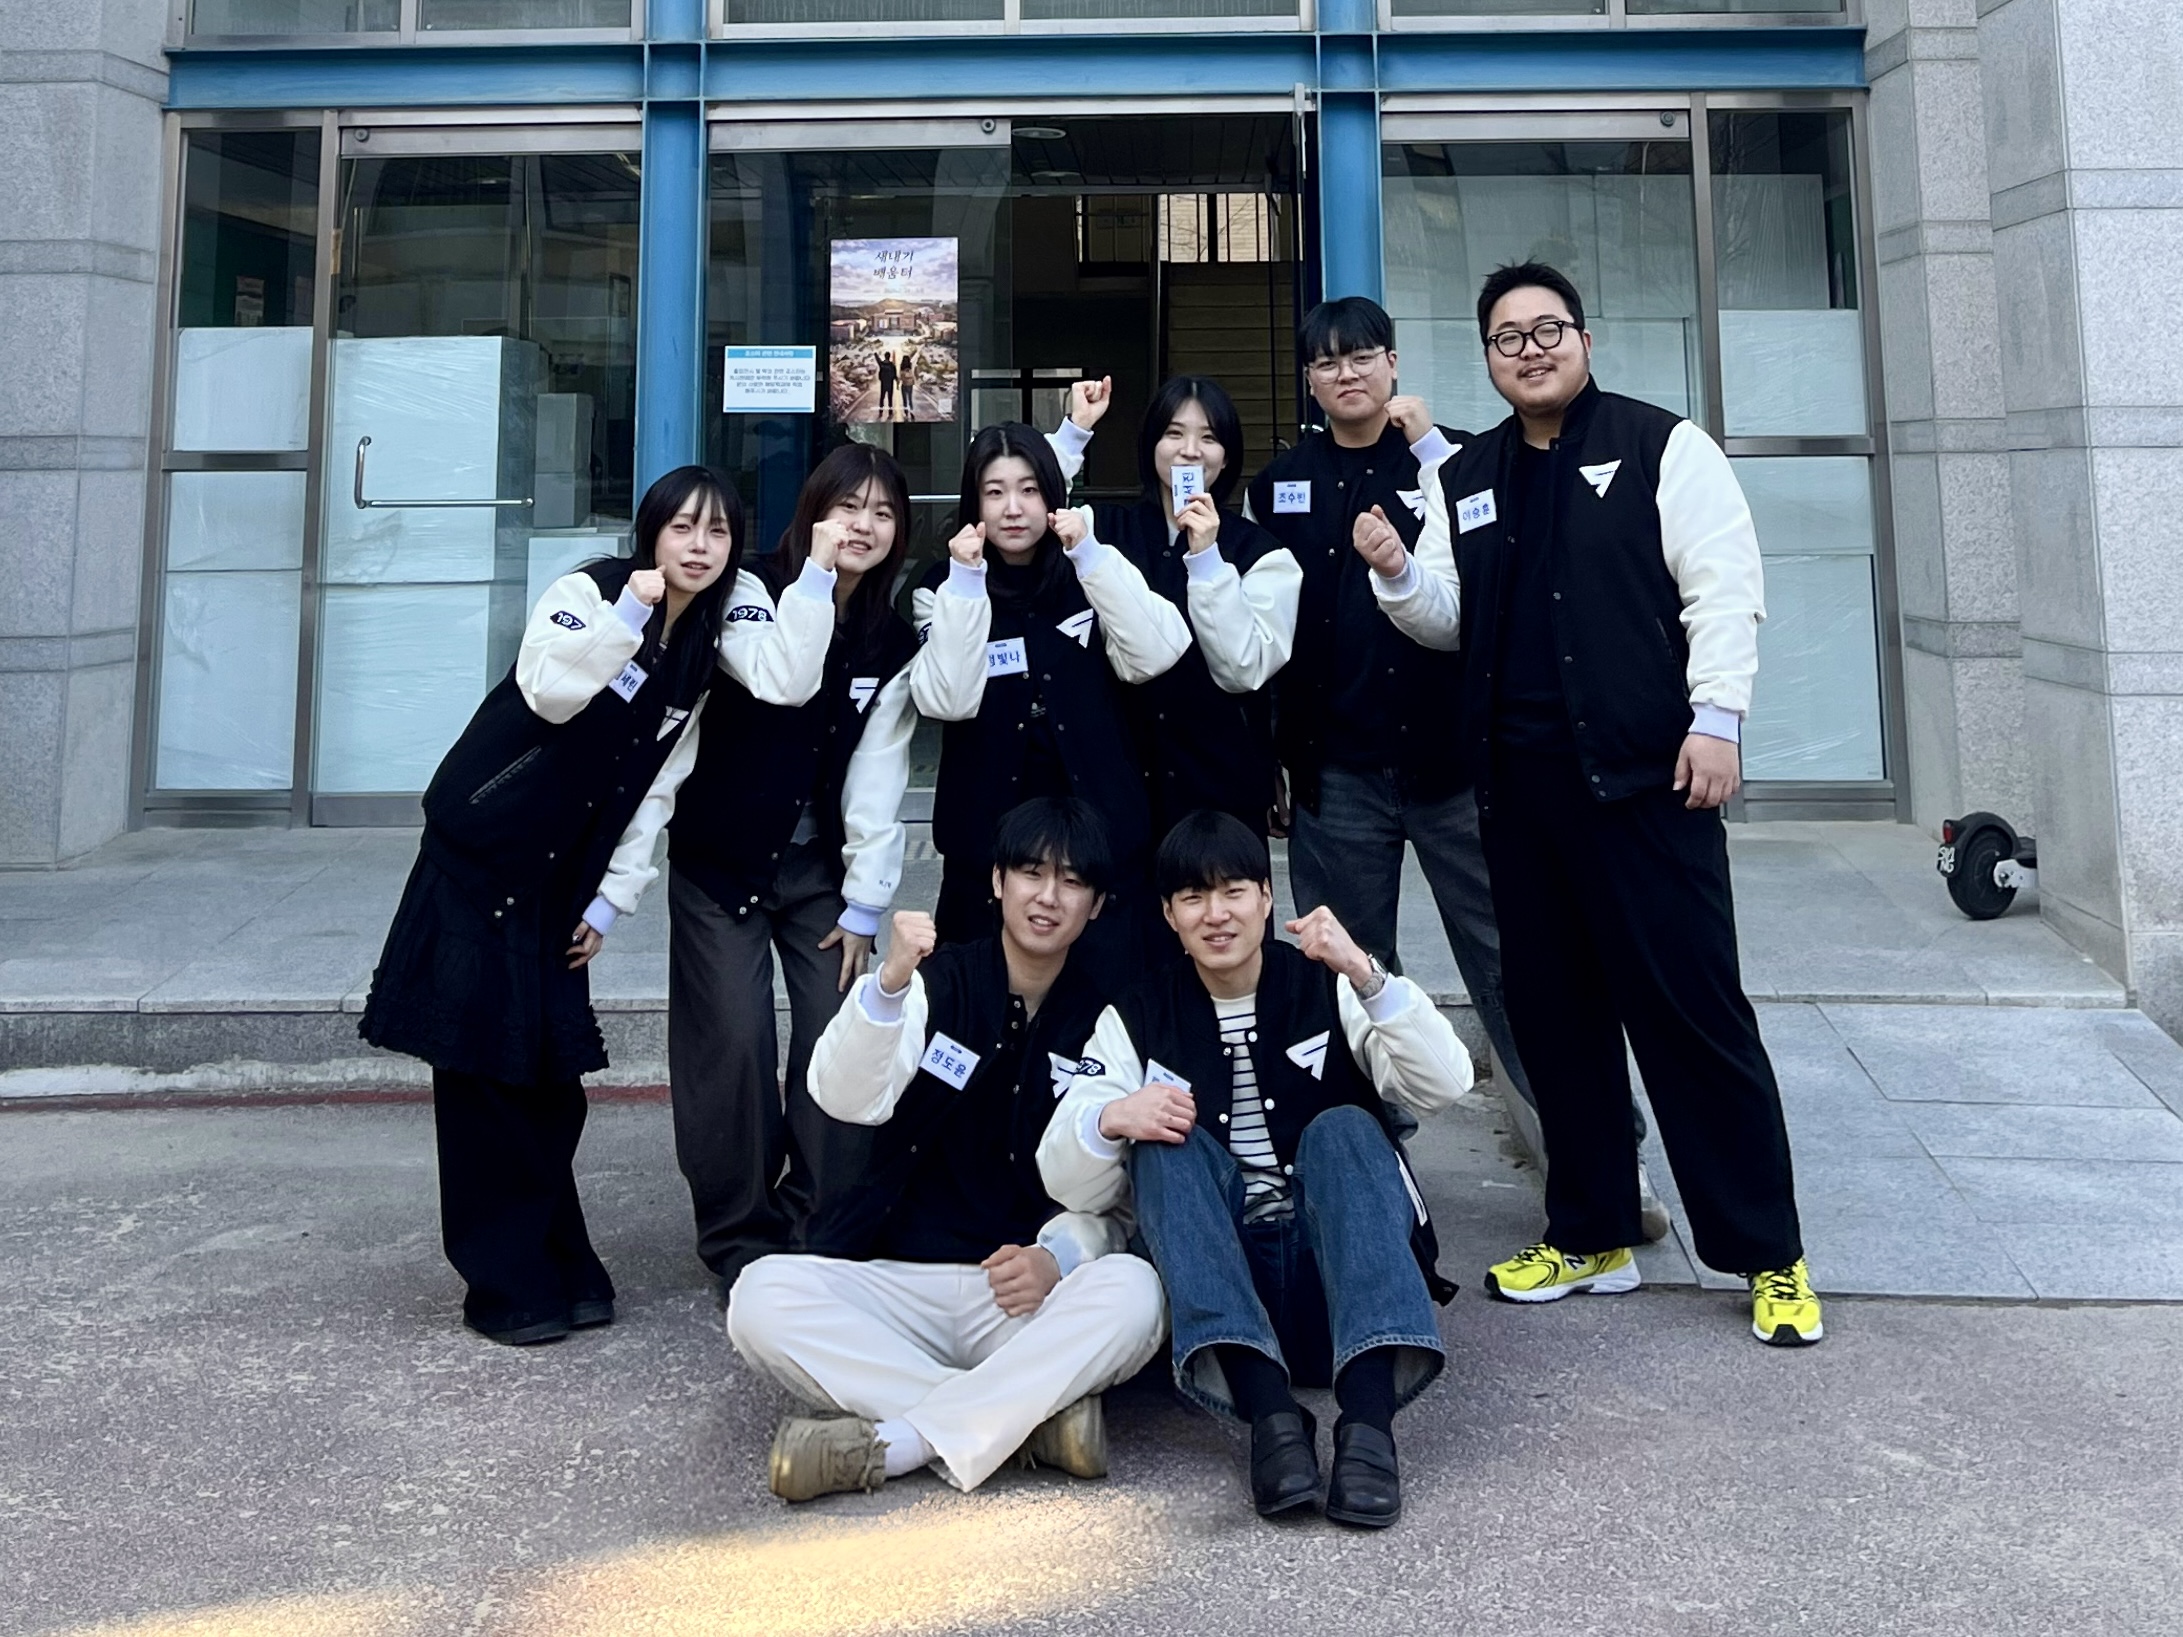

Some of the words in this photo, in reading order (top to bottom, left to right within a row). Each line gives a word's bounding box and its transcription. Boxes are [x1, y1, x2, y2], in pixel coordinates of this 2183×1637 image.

[874, 249, 914, 263] 새내기
[873, 265, 913, 279] 배움터
[1182, 472, 1194, 506] 서진
[733, 607, 767, 621] 1978
[931, 1048, 967, 1079] 정도윤
